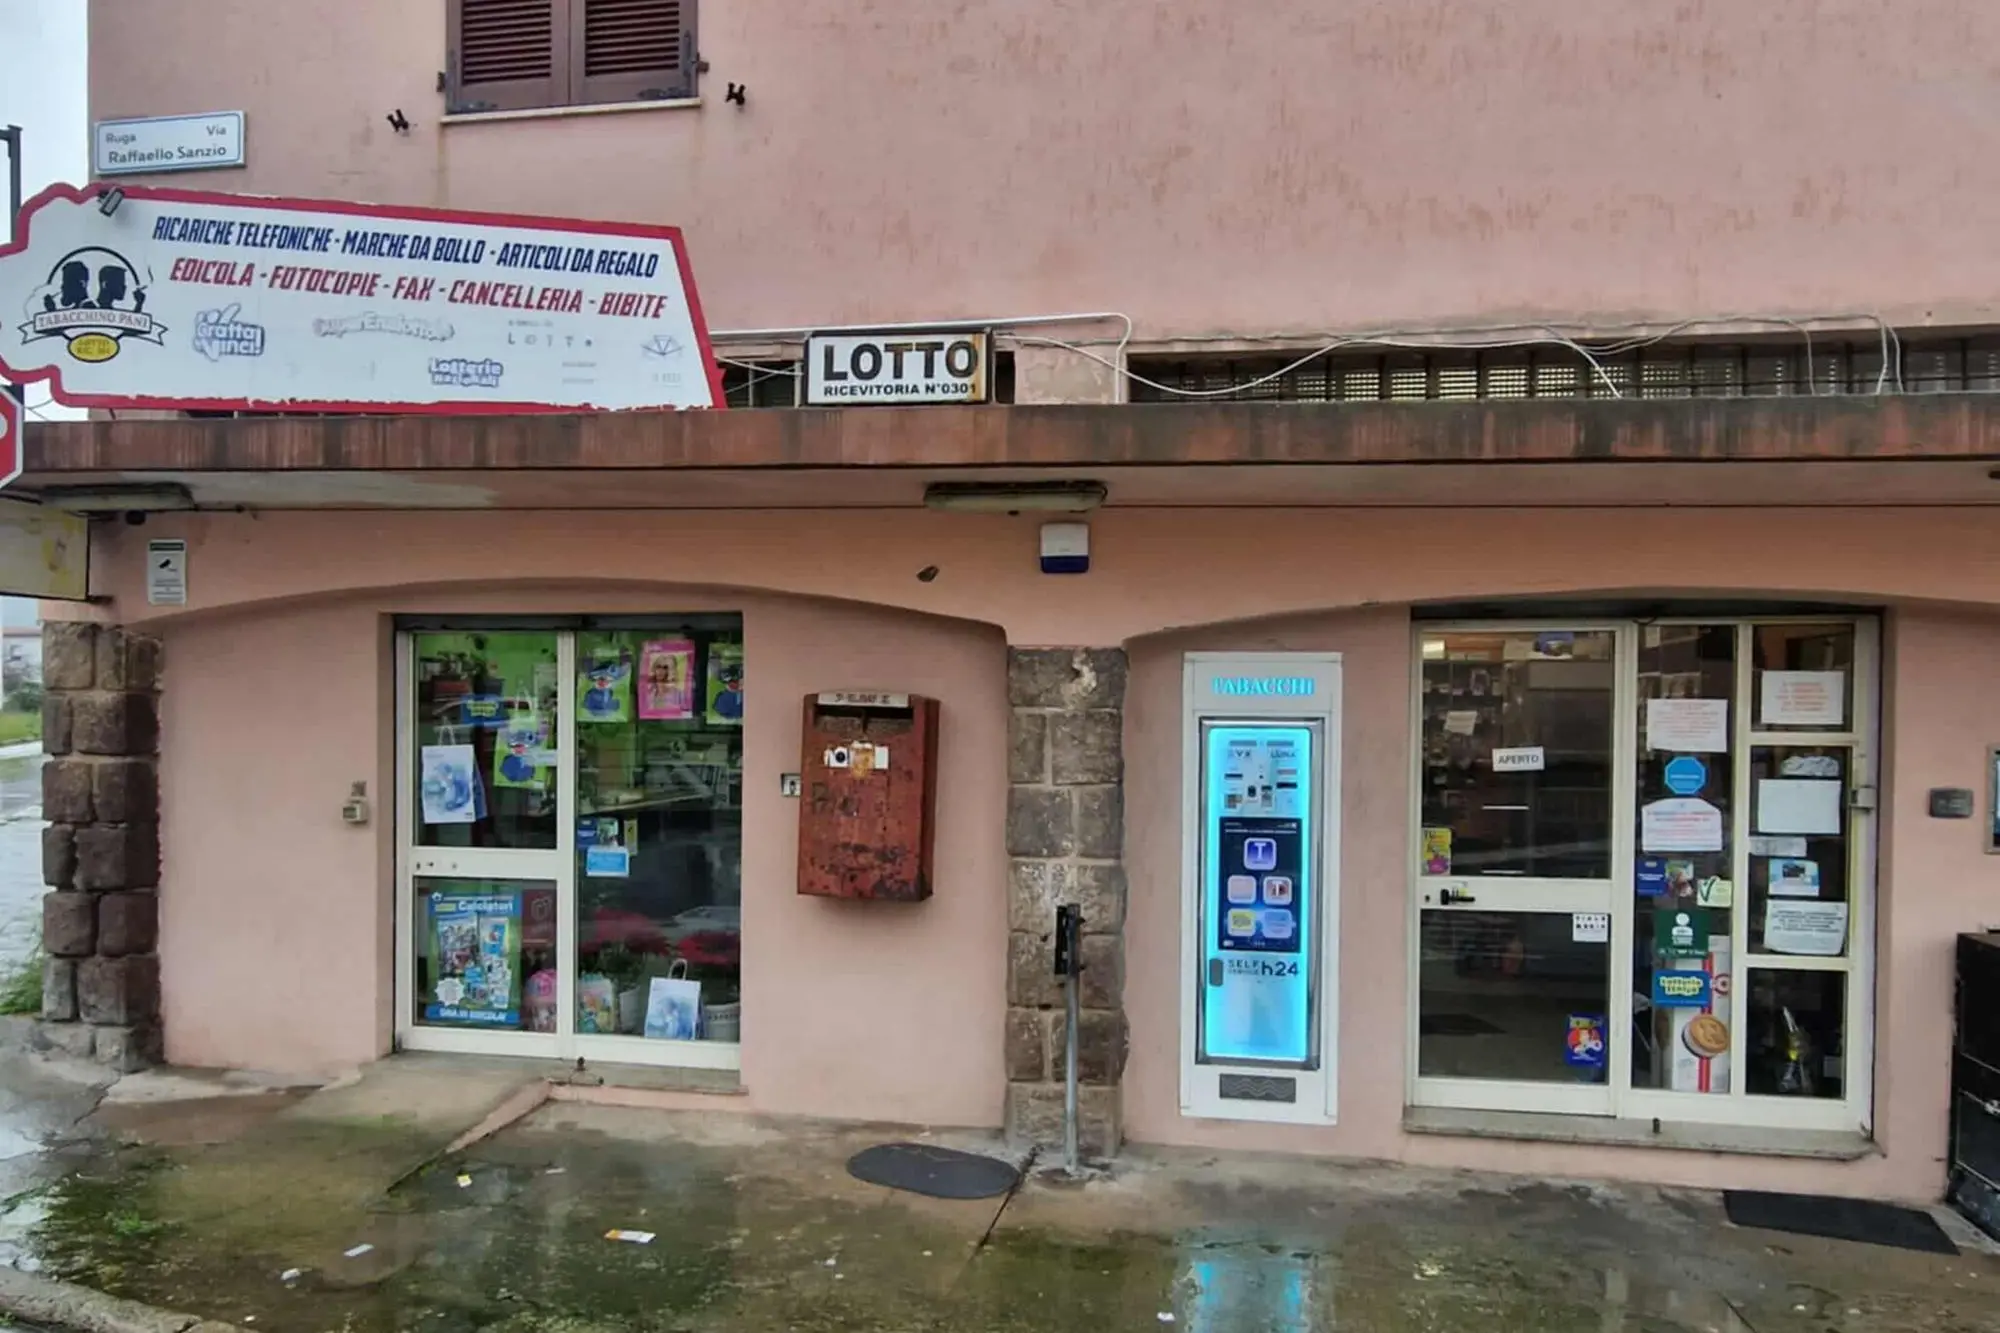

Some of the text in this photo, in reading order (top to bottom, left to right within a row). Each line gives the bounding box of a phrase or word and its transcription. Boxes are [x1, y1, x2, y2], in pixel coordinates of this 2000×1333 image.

[105, 125, 227, 145] Ruga Via
[108, 145, 227, 163] Raffaello Sanzio
[152, 216, 659, 279] RICARICHE TELEFONICHE MARCHE DA BOLLO ARTICOLI DA REGALO
[169, 257, 668, 319] EDICOLA FOTOCOPIE FAX CANCELLERIA BIBITE
[39, 310, 149, 328] TABACCHINO PANI
[823, 340, 978, 381] LOTTO
[824, 384, 920, 396] RICEVITORIA
[1212, 676, 1315, 696] TABACCHI
[1498, 754, 1539, 765] APERTO
[1261, 960, 1299, 977] h24
